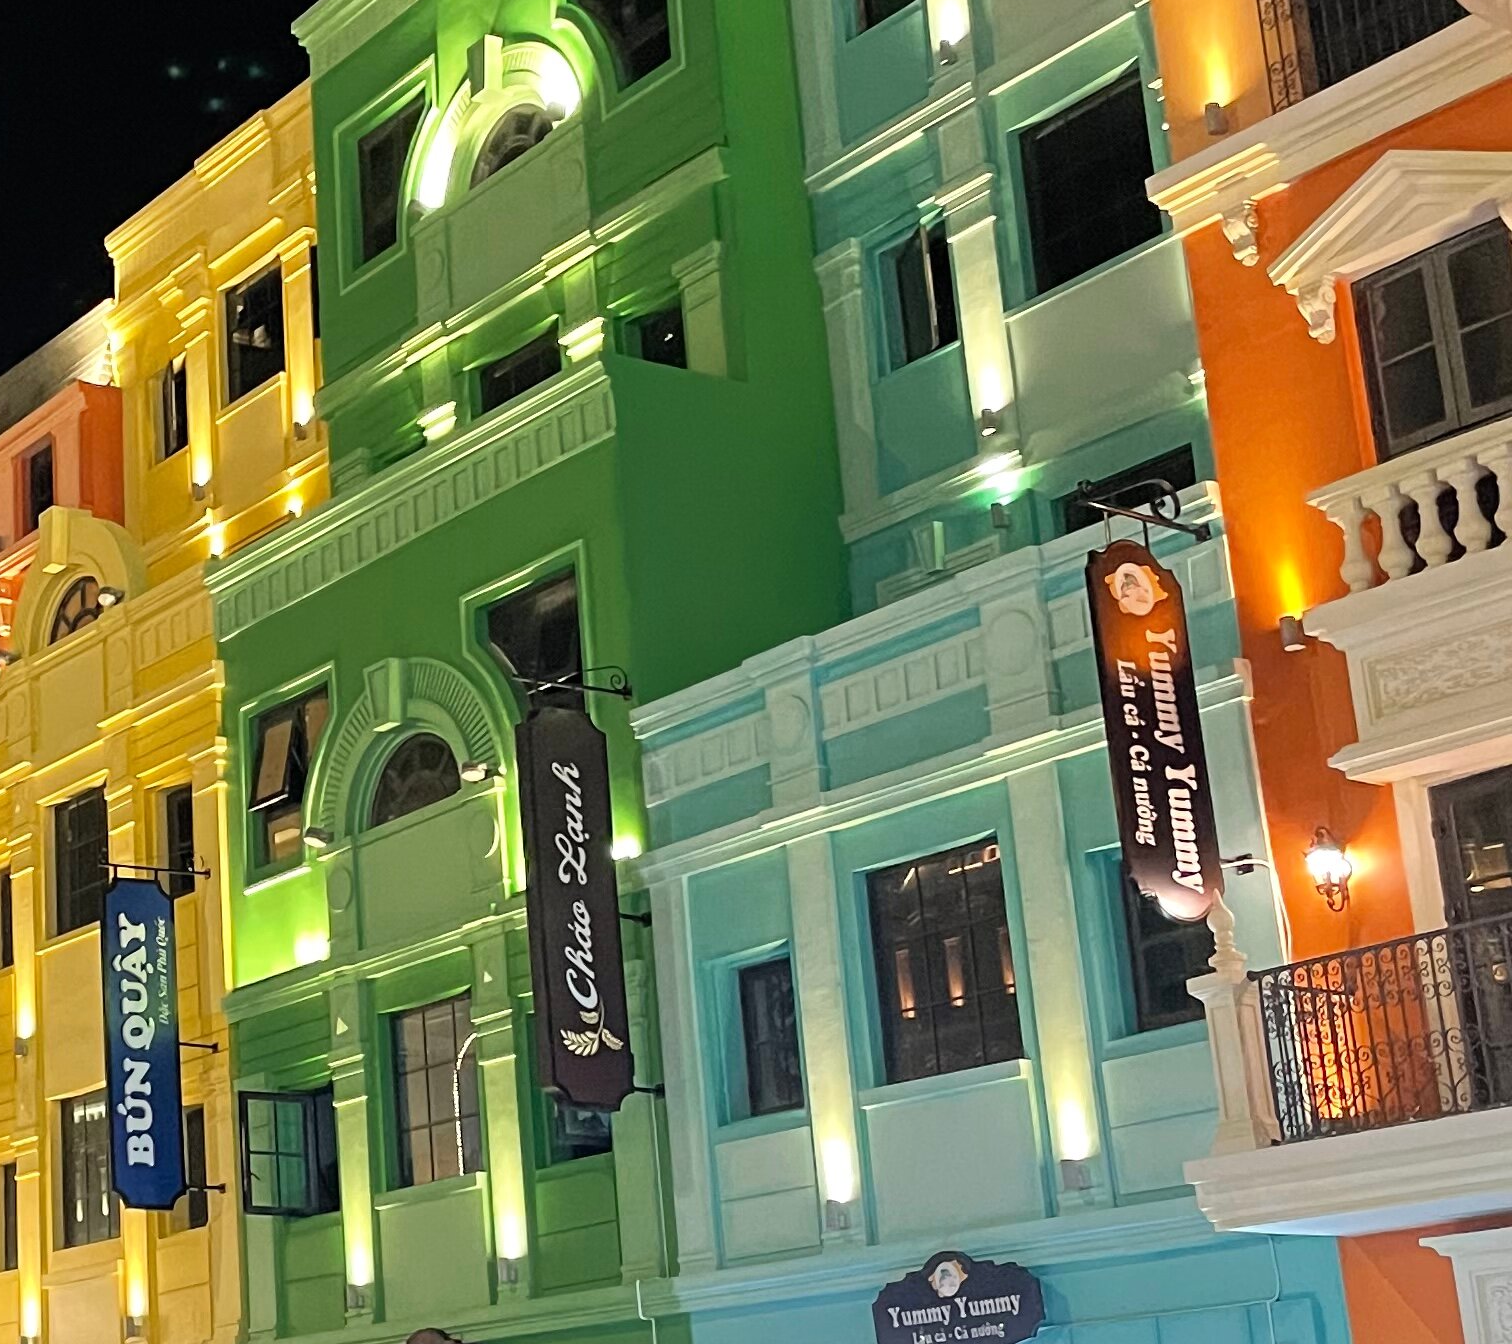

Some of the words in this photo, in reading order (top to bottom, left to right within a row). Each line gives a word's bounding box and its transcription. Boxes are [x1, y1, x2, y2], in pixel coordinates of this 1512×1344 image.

[1115, 658, 1137, 699] Lẩu
[1121, 701, 1143, 728] cá
[1128, 743, 1152, 772] Cá
[1144, 627, 1186, 756] Yummy
[1165, 762, 1206, 895] Yummy
[552, 760, 591, 887] Lạnh
[1133, 775, 1157, 847] nướng
[112, 911, 156, 1051] QUẬY
[564, 898, 602, 1014] Cháo
[116, 1056, 156, 1168] BÚN
[887, 1304, 952, 1329] Yummy
[954, 1294, 1021, 1319] Yummy
